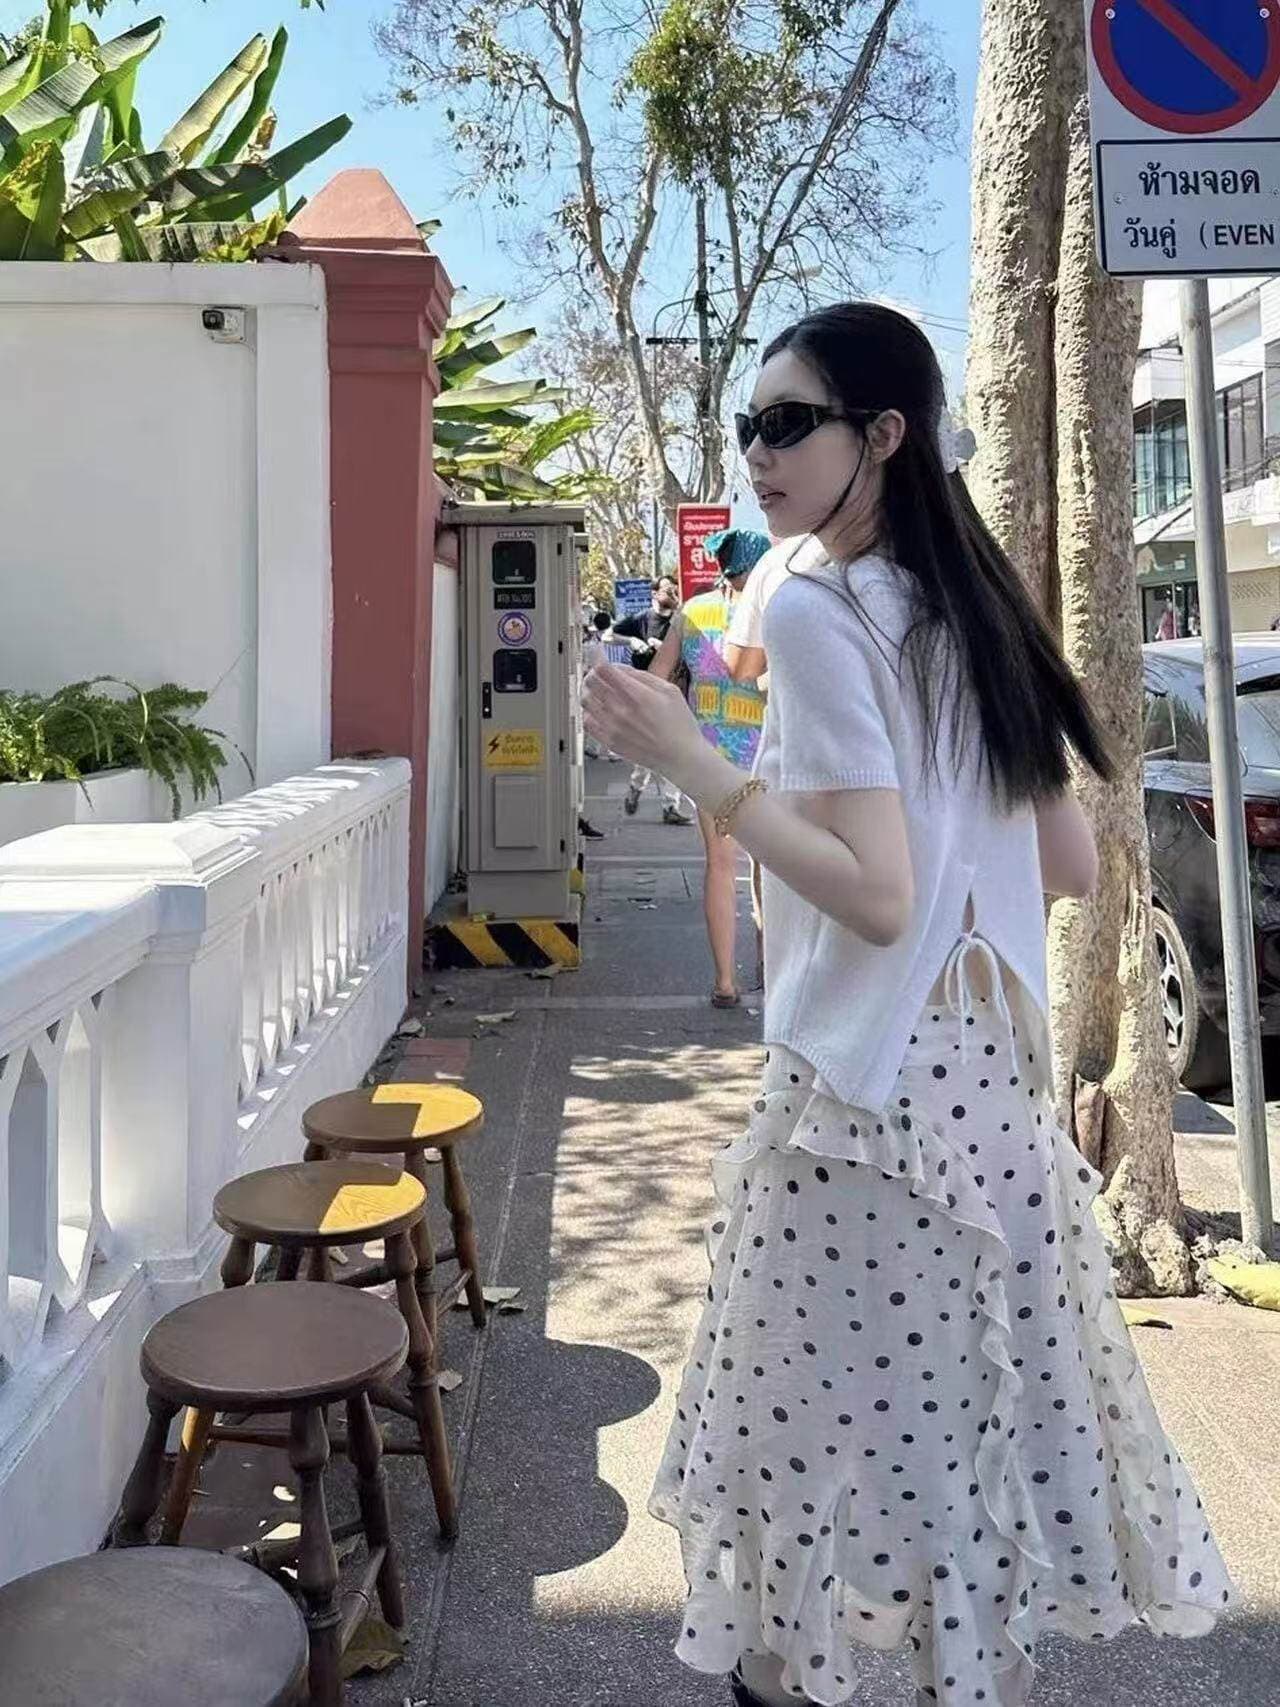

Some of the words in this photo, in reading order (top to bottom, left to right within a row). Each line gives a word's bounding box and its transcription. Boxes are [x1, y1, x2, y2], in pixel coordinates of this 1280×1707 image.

[1138, 161, 1260, 196] ห้ามจอด
[1123, 217, 1177, 259] วันคู่
